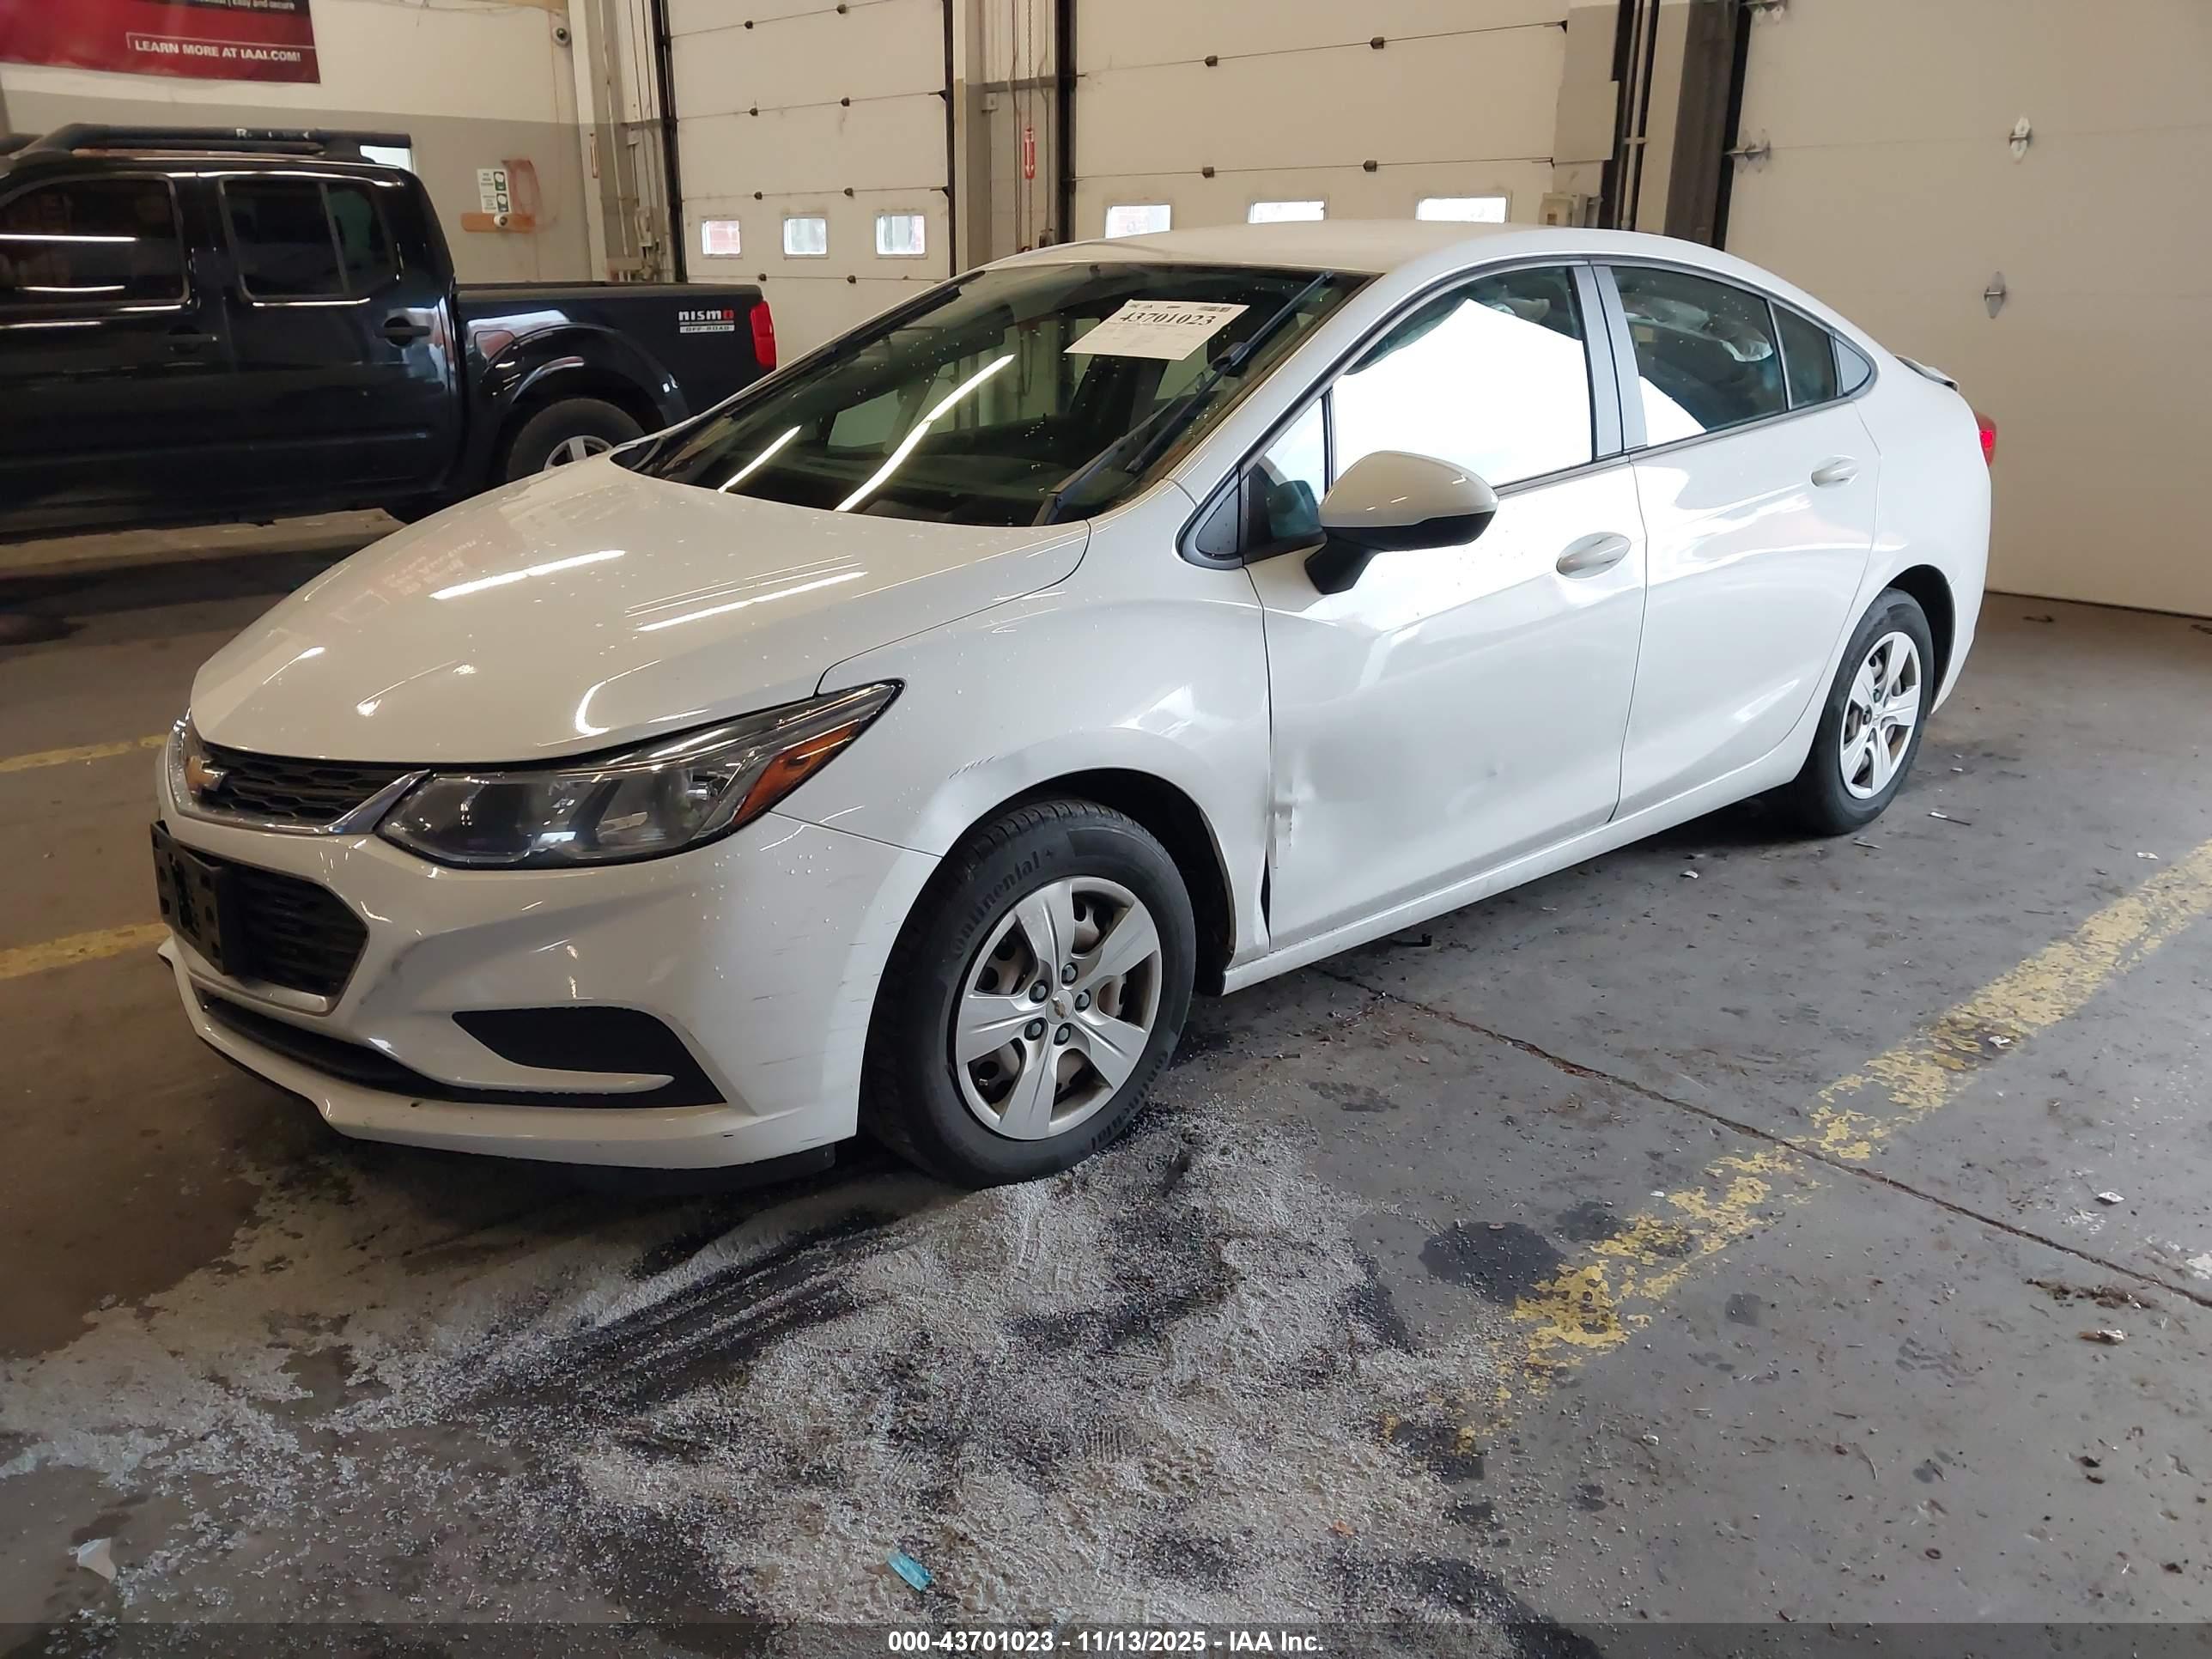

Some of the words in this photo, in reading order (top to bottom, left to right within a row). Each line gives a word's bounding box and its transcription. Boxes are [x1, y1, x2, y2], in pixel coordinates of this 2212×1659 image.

[135, 40, 179, 54] LEARN
[182, 44, 219, 58] MORE
[222, 47, 237, 58] AT
[240, 49, 301, 63] IAAI.COM!
[678, 310, 734, 321] nismo
[1119, 311, 1217, 326] 43701023
